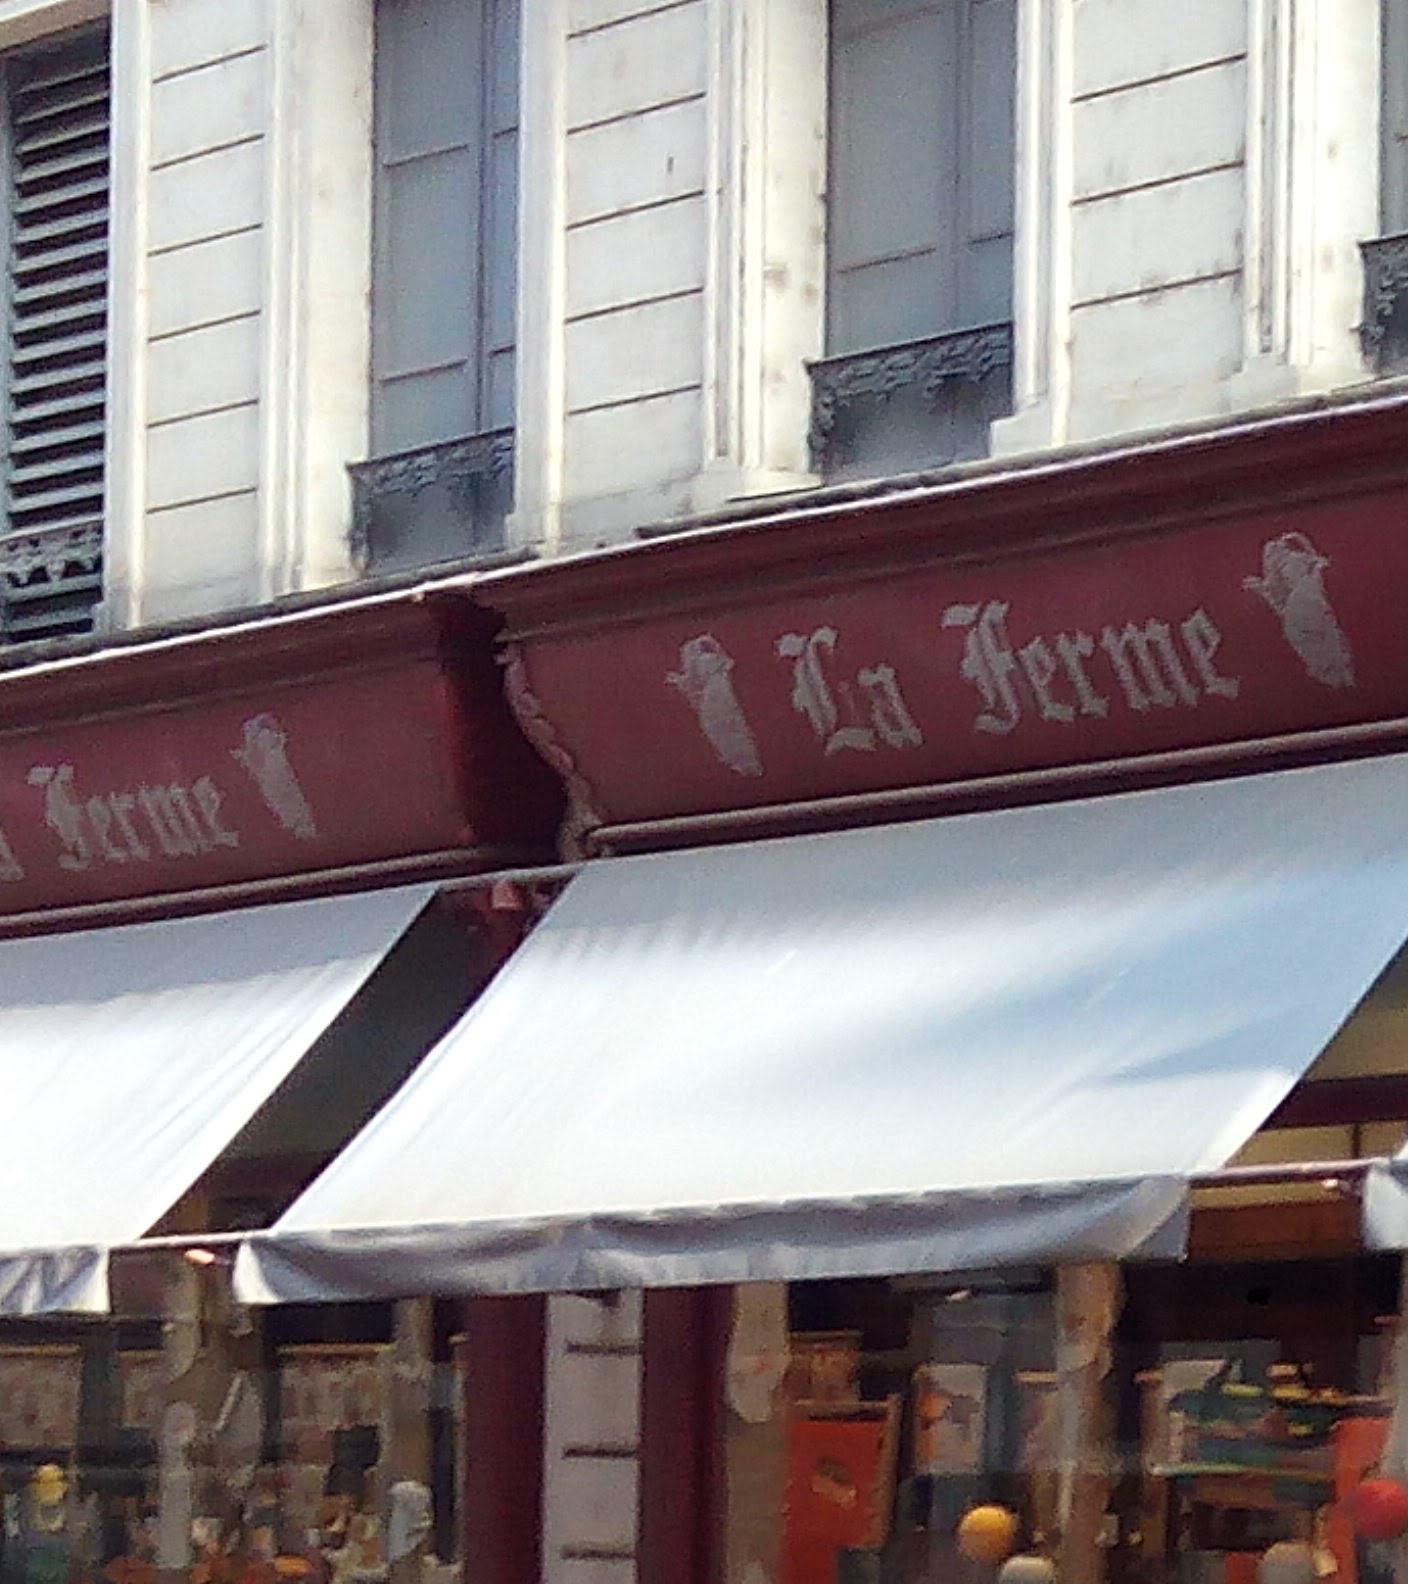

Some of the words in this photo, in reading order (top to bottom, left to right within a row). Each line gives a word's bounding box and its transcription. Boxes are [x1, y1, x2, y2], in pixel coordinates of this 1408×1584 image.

[774, 627, 924, 756] La
[941, 600, 1239, 735] Ferme
[25, 762, 241, 871] Ferme
